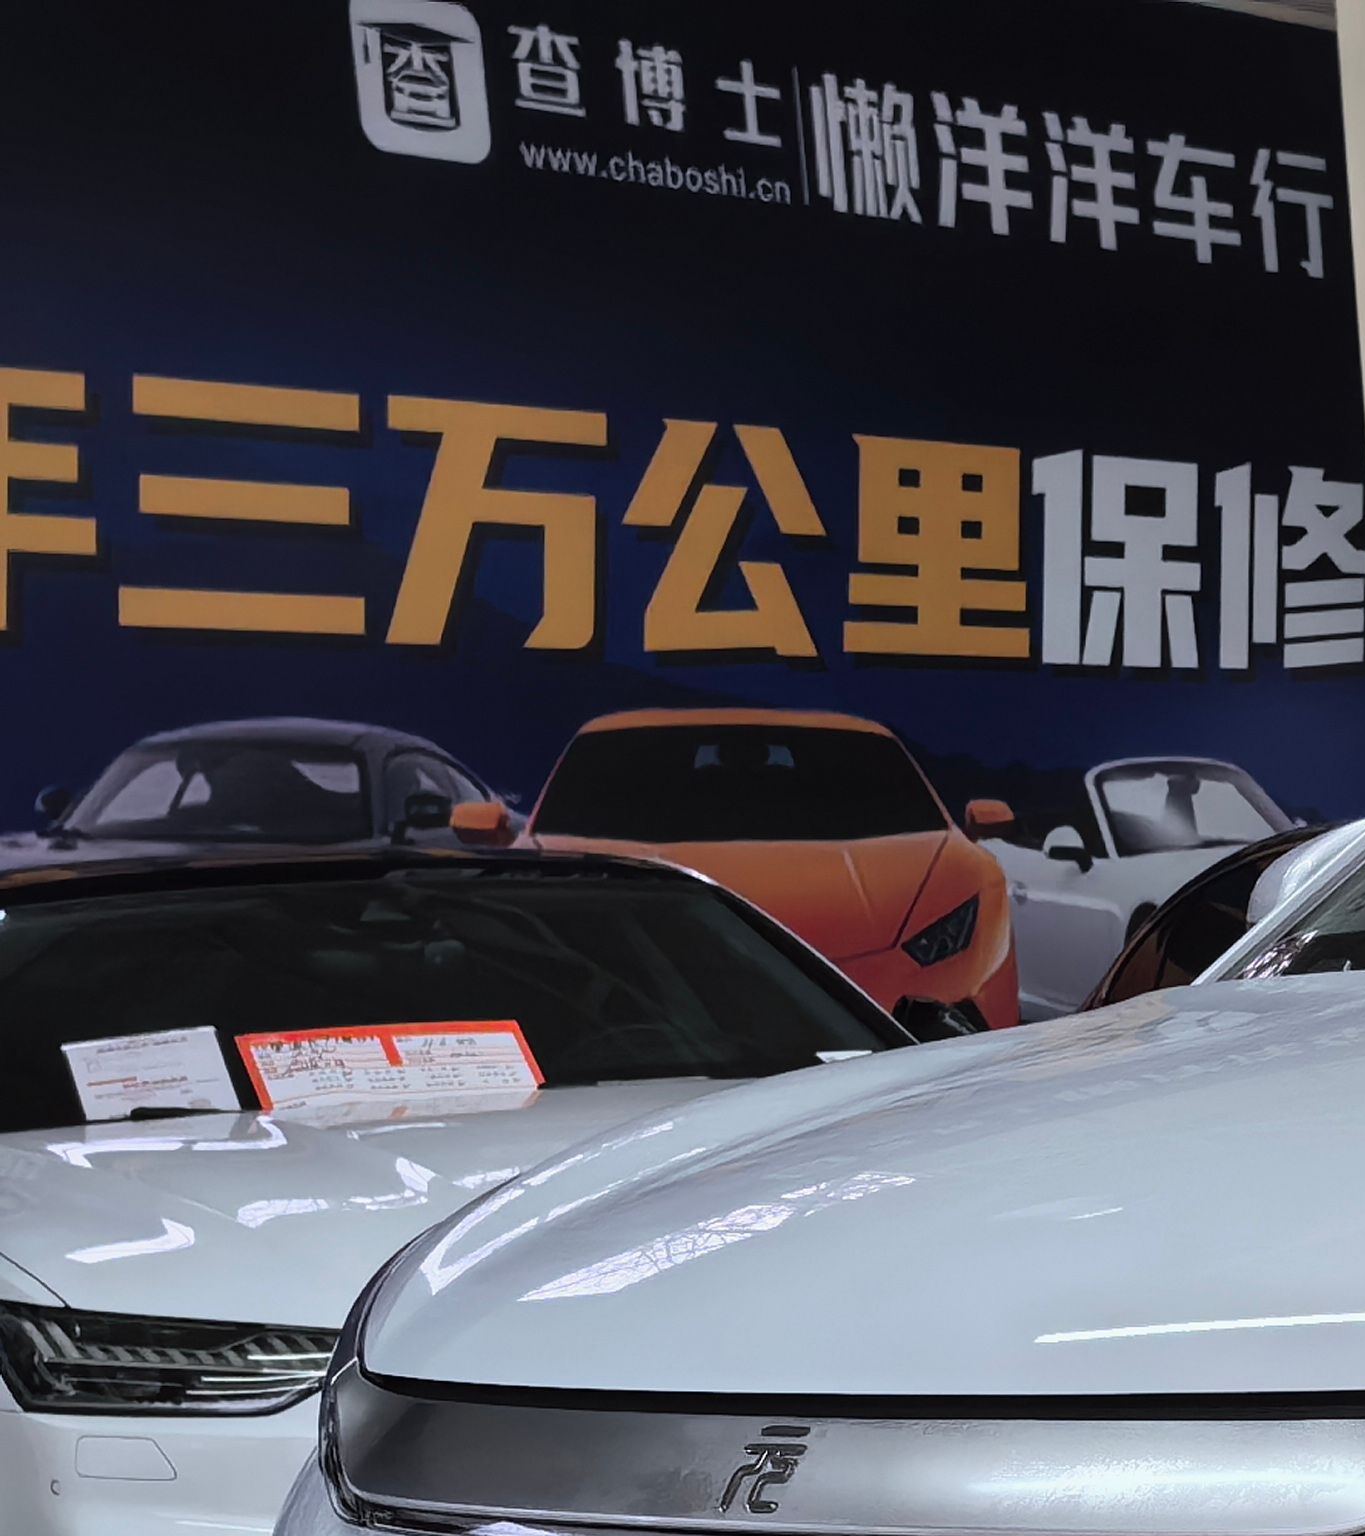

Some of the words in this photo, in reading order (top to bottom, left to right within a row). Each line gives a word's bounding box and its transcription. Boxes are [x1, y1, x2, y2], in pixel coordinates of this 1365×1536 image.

[507, 24, 784, 148] 查博士
[808, 69, 1336, 279] 懒洋洋车行
[519, 141, 792, 205] www.chaboshi.cn
